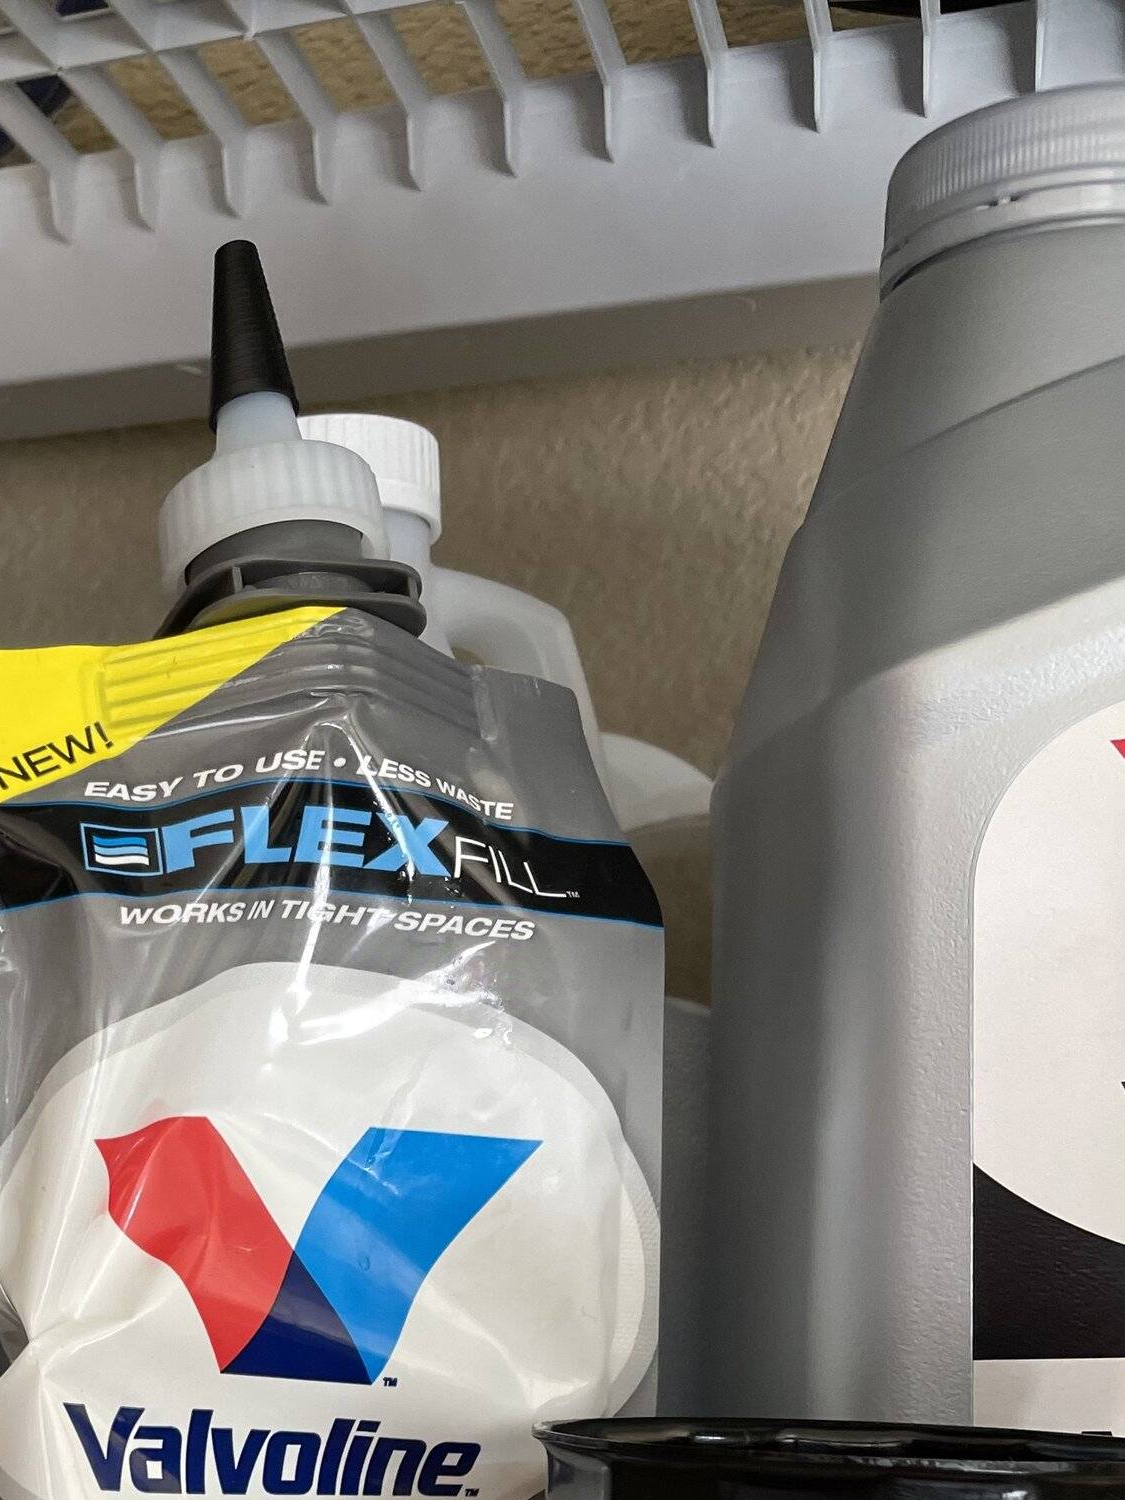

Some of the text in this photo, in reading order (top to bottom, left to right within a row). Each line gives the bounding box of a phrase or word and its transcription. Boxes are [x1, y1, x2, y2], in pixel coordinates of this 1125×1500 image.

[83, 749, 514, 822] EASY TO USE LESS WASTE
[118, 900, 536, 941] WORKS IN TIGHT SPACES
[63, 1402, 481, 1497] Valvoline
